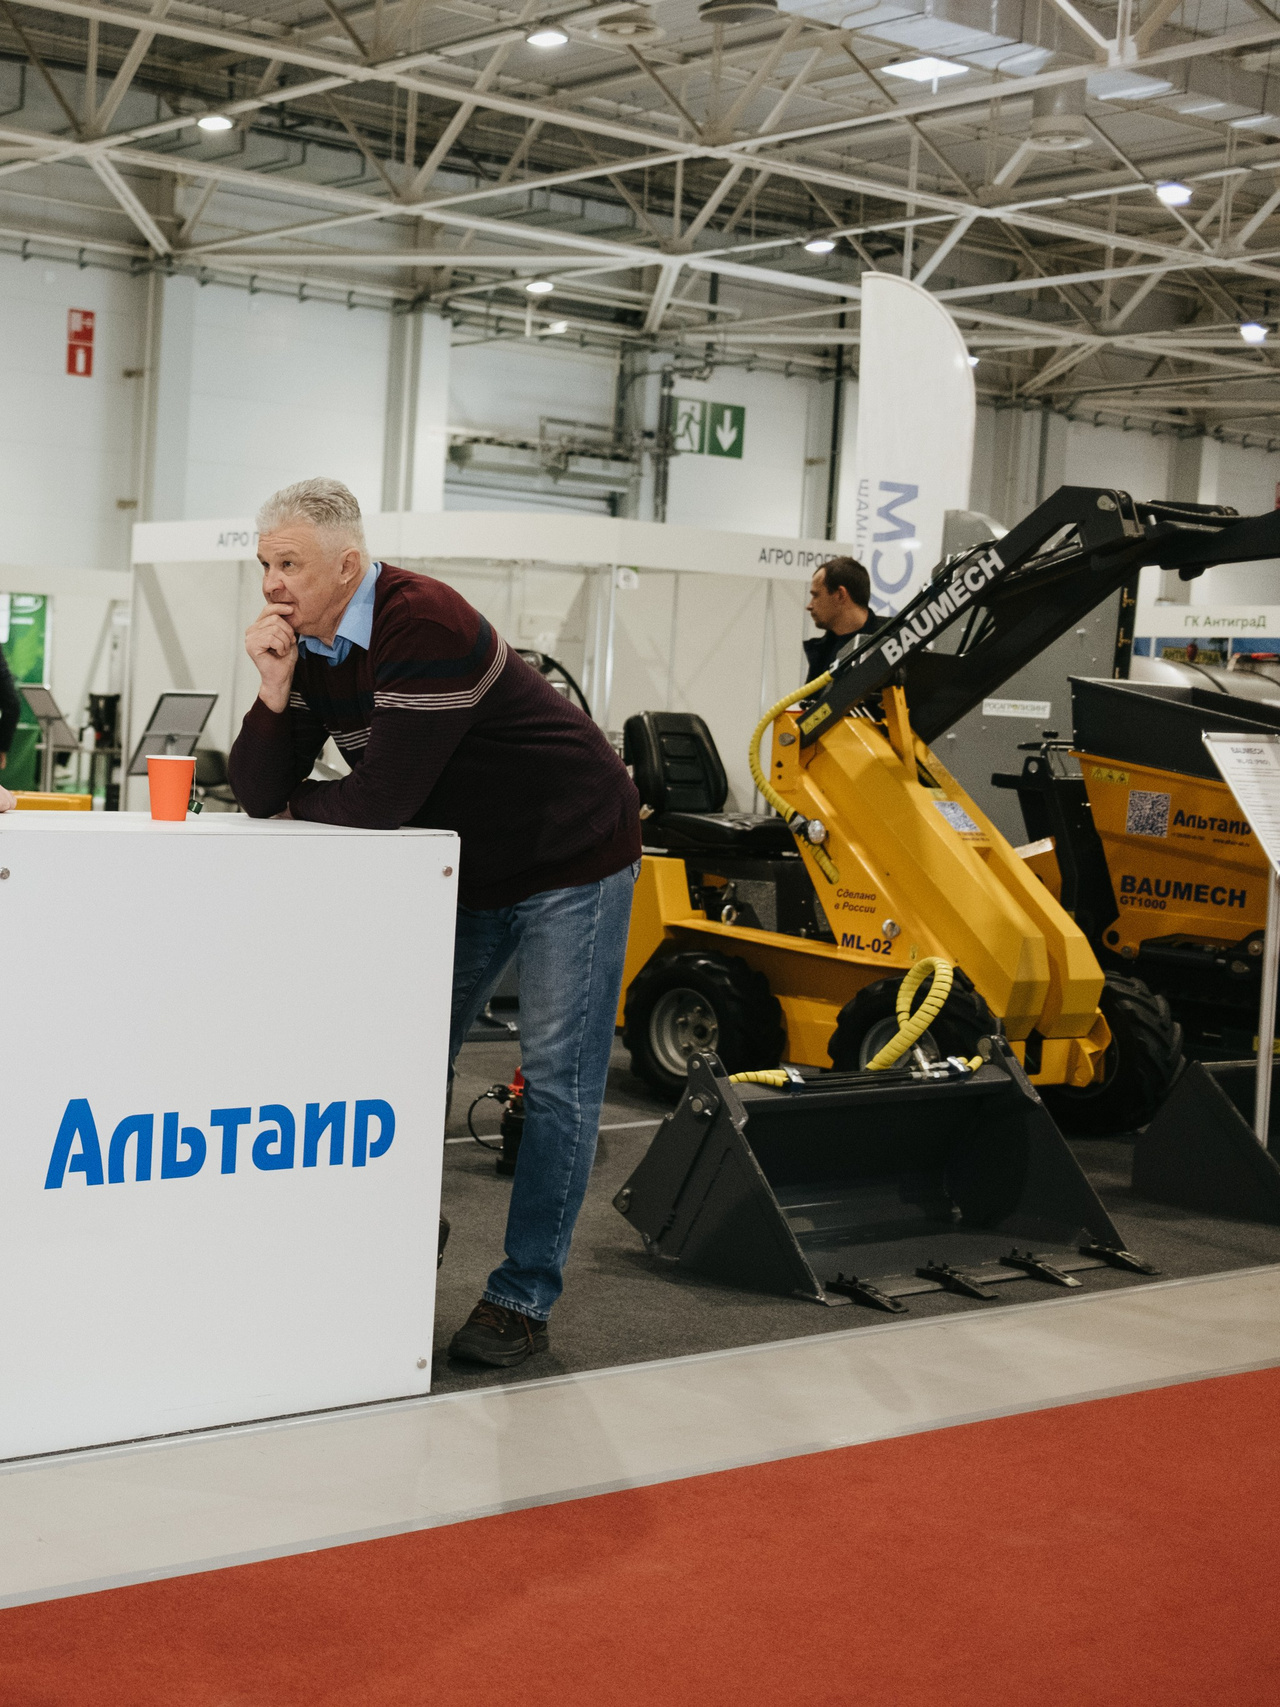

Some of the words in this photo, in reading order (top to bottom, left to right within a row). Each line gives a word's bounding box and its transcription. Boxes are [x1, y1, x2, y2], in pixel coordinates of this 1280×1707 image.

[218, 531, 249, 547] АГРО
[758, 548, 794, 566] АГРО
[880, 548, 1005, 666] BAUMECH
[1184, 615, 1201, 627] ГК
[1203, 615, 1267, 629] АнтиграД
[1173, 809, 1252, 836] Альтаир
[836, 888, 877, 901] Сделано
[1120, 875, 1247, 908] BAUMECH
[842, 901, 876, 914] России
[1120, 895, 1167, 910] GT1000
[841, 932, 892, 955] ML-02
[44, 1098, 396, 1190] Альтаир
